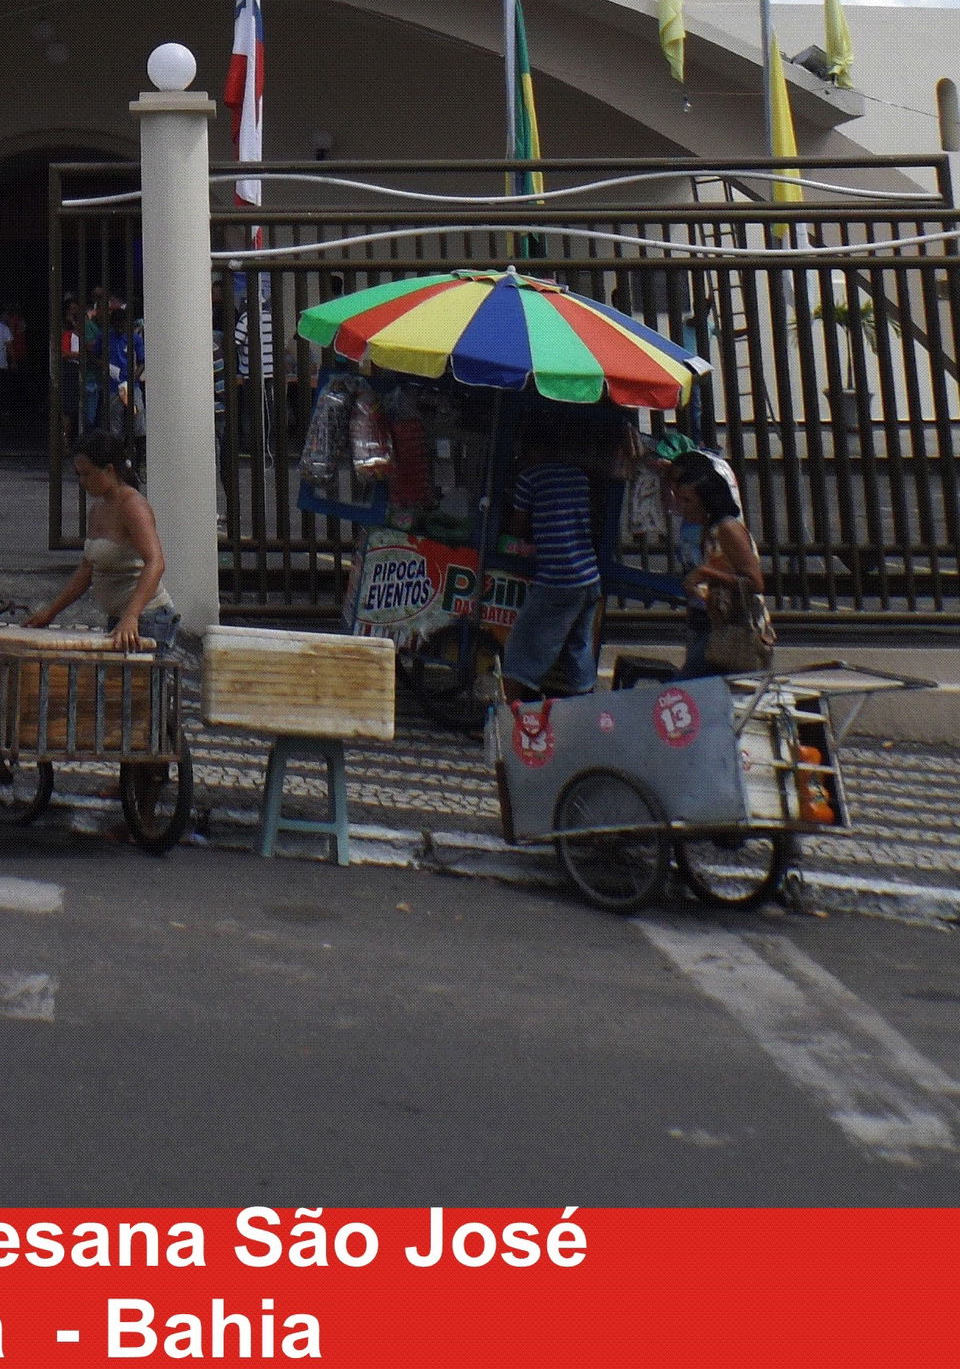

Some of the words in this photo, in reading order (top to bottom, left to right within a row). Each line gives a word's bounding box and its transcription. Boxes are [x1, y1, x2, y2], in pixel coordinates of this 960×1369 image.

[372, 558, 427, 583] PIPOCA
[365, 579, 431, 611] EVENTOS
[441, 563, 528, 612] Poin
[659, 701, 692, 733] 13
